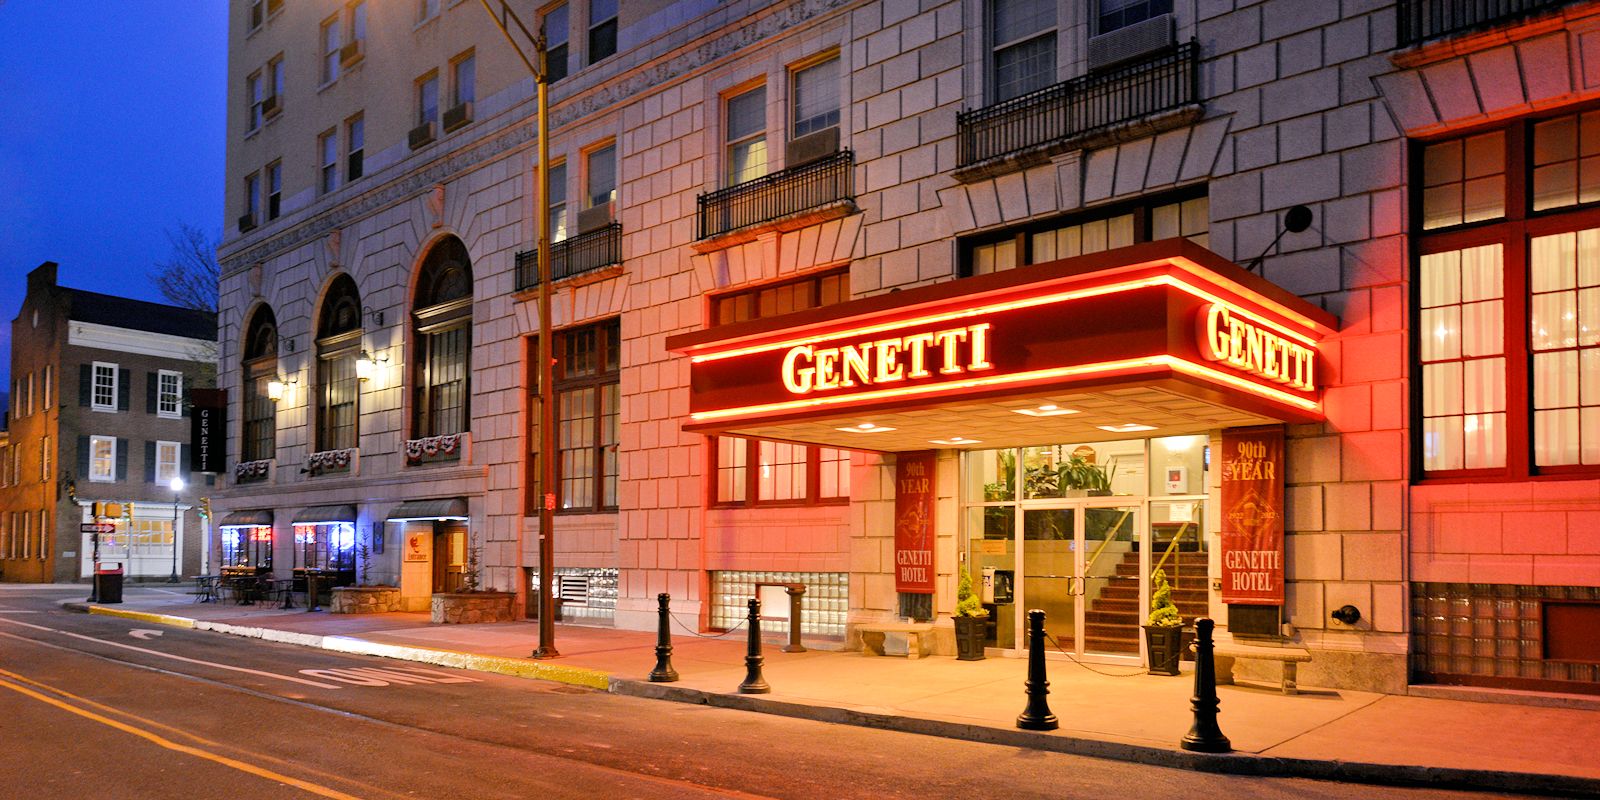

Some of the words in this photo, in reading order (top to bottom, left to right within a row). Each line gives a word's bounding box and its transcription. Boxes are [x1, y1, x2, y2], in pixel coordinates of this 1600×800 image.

[1206, 302, 1315, 392] GENETTI
[781, 322, 993, 394] GENETTI
[200, 409, 209, 471] GENETTI
[1237, 441, 1267, 459] 90th
[906, 462, 925, 477] 90th
[1230, 461, 1276, 481] YEAR
[901, 478, 930, 494] YEAR
[897, 549, 932, 566] GENETTI
[1225, 550, 1281, 570] GENETTI
[901, 567, 928, 583] HOTEL
[1231, 571, 1273, 592] HOTEL
